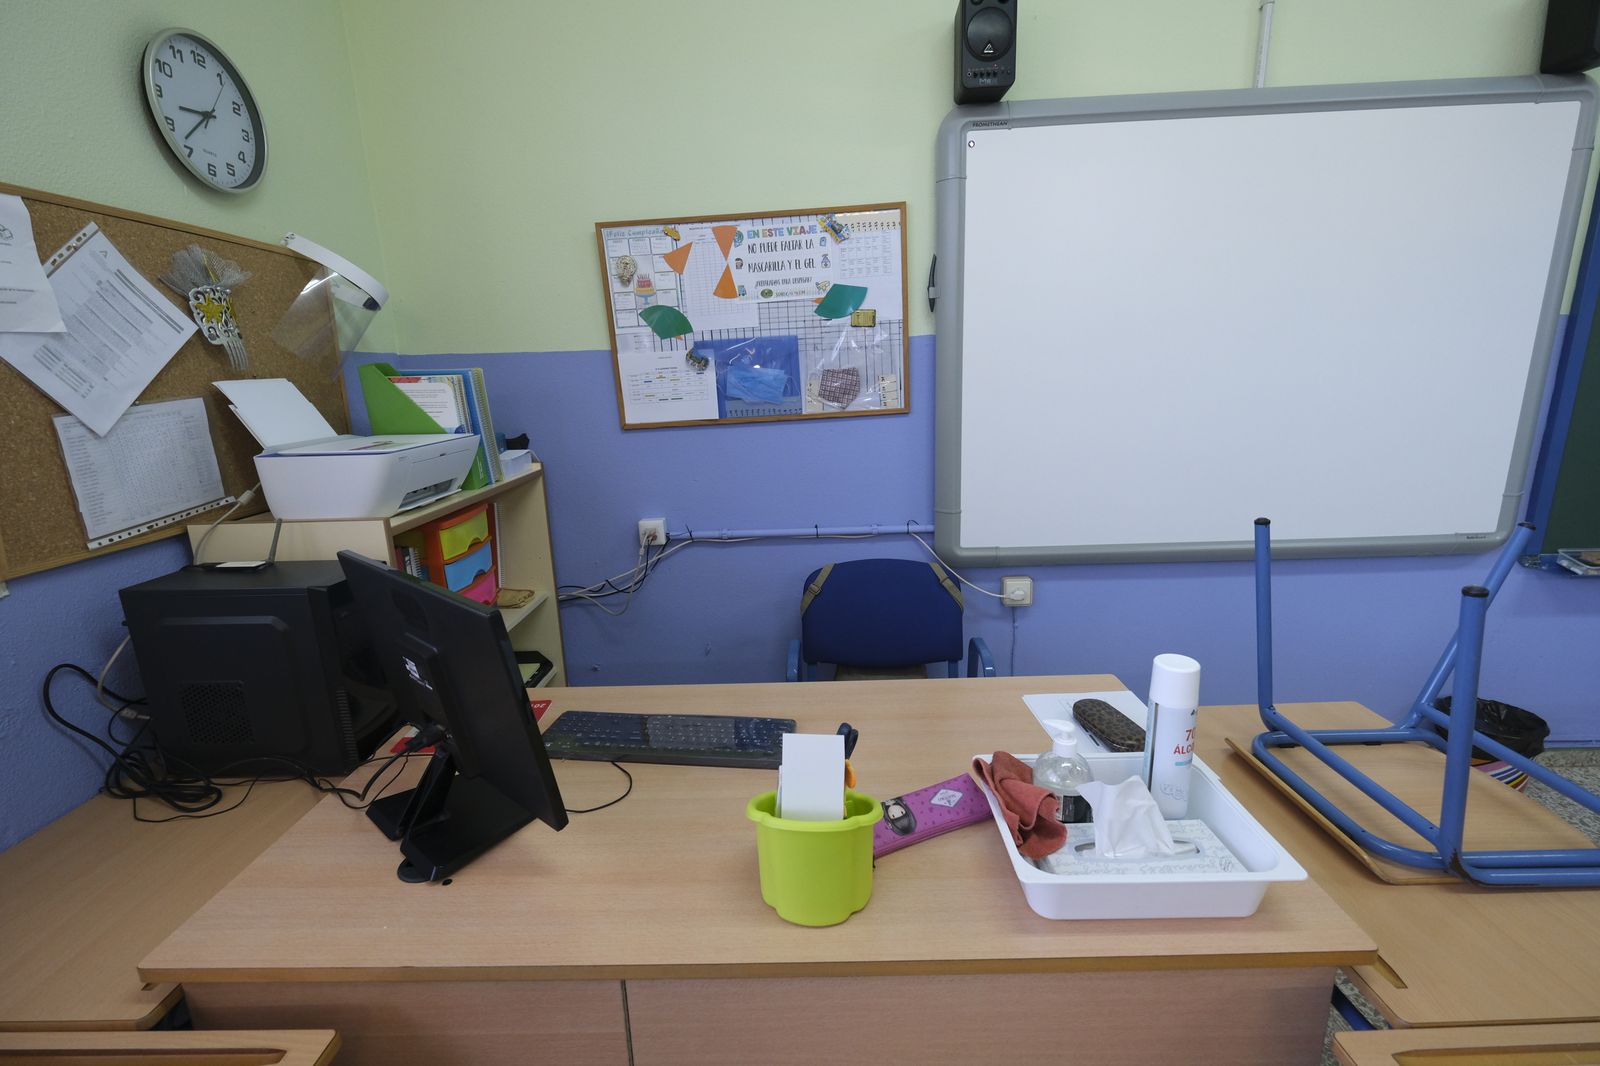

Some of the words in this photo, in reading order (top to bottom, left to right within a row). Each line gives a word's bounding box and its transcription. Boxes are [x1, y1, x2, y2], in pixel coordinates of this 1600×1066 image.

[169, 45, 184, 63] 11
[190, 50, 206, 69] 12
[155, 58, 173, 78] 10
[216, 72, 223, 87] 1
[232, 100, 241, 117] 2
[241, 128, 250, 143] 3
[183, 144, 193, 159] 7
[237, 150, 247, 164] 4
[207, 162, 217, 178] 6
[225, 161, 236, 177] 5
[747, 229, 760, 239] EN
[762, 227, 785, 238] ESTE
[787, 224, 818, 236] VIAJE
[747, 243, 757, 254] NO
[759, 241, 778, 253] PUEDE
[780, 239, 803, 251] FALTAR
[805, 238, 815, 250] LA
[748, 260, 786, 273] MASCARILLA
[786, 259, 793, 271] Y
[794, 259, 802, 270] EL
[804, 258, 816, 269] GEL
